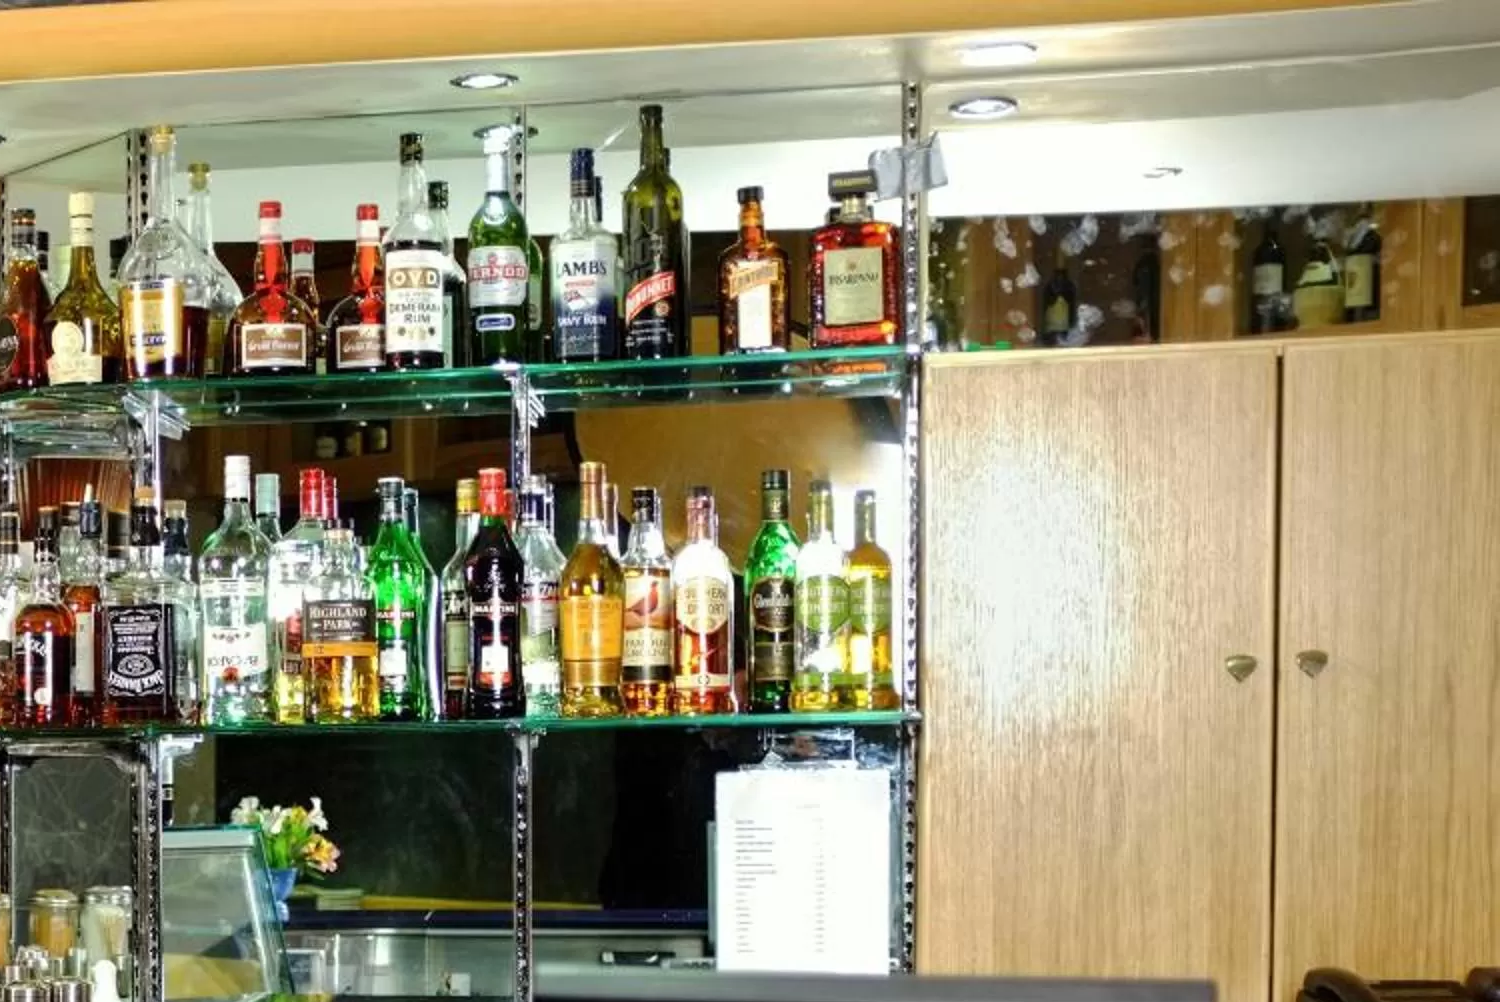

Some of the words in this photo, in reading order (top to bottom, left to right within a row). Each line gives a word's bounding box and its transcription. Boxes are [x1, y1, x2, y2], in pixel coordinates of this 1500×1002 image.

[403, 313, 432, 325] RUM
[308, 606, 368, 619] HIGHLAND
[376, 610, 415, 620] MARINI
[322, 618, 353, 632] PARK
